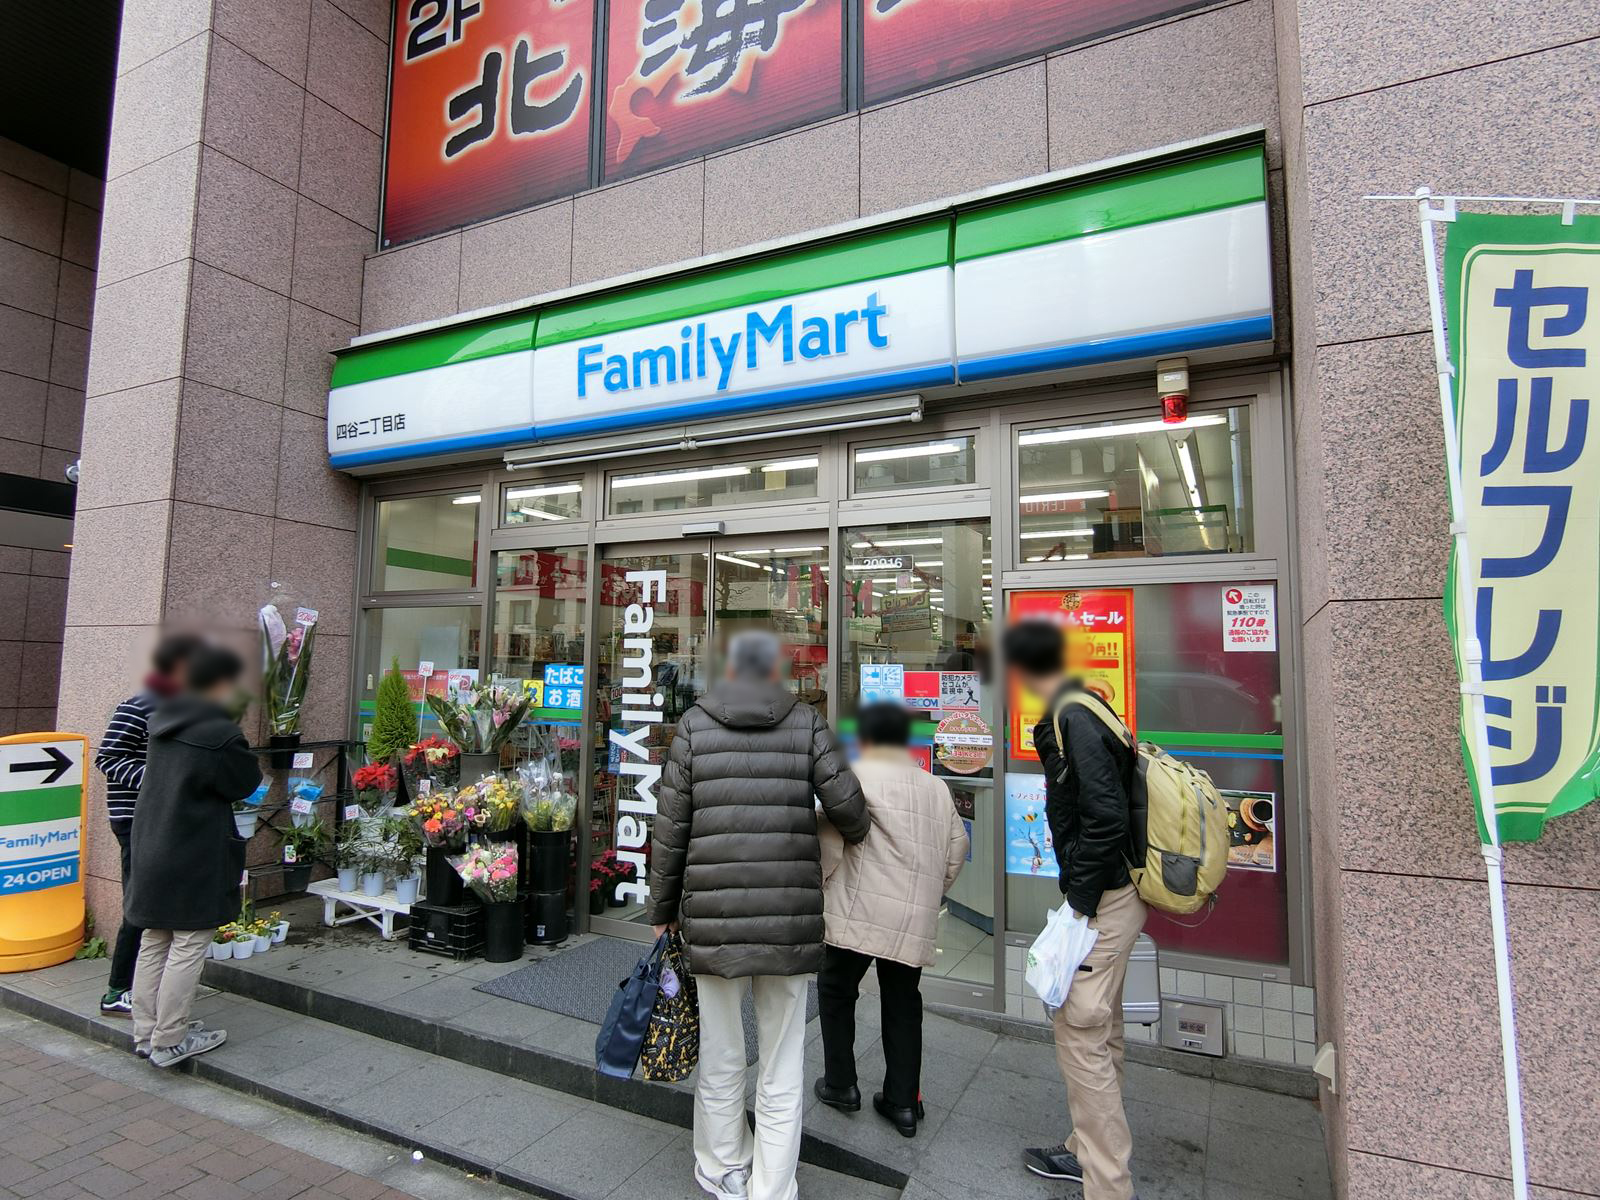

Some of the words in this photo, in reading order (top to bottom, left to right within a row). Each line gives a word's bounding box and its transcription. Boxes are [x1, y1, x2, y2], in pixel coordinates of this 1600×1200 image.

[407, 0, 480, 60] 2F
[577, 291, 888, 398] FamilyMart
[336, 413, 406, 440] 四谷二丁目店
[1478, 268, 1588, 786] セルフレジ
[1231, 617, 1266, 628] 110番
[545, 667, 584, 686] たばこ
[549, 688, 582, 706] お酒
[905, 698, 939, 707] SECOM
[609, 569, 667, 905] FamilyMart
